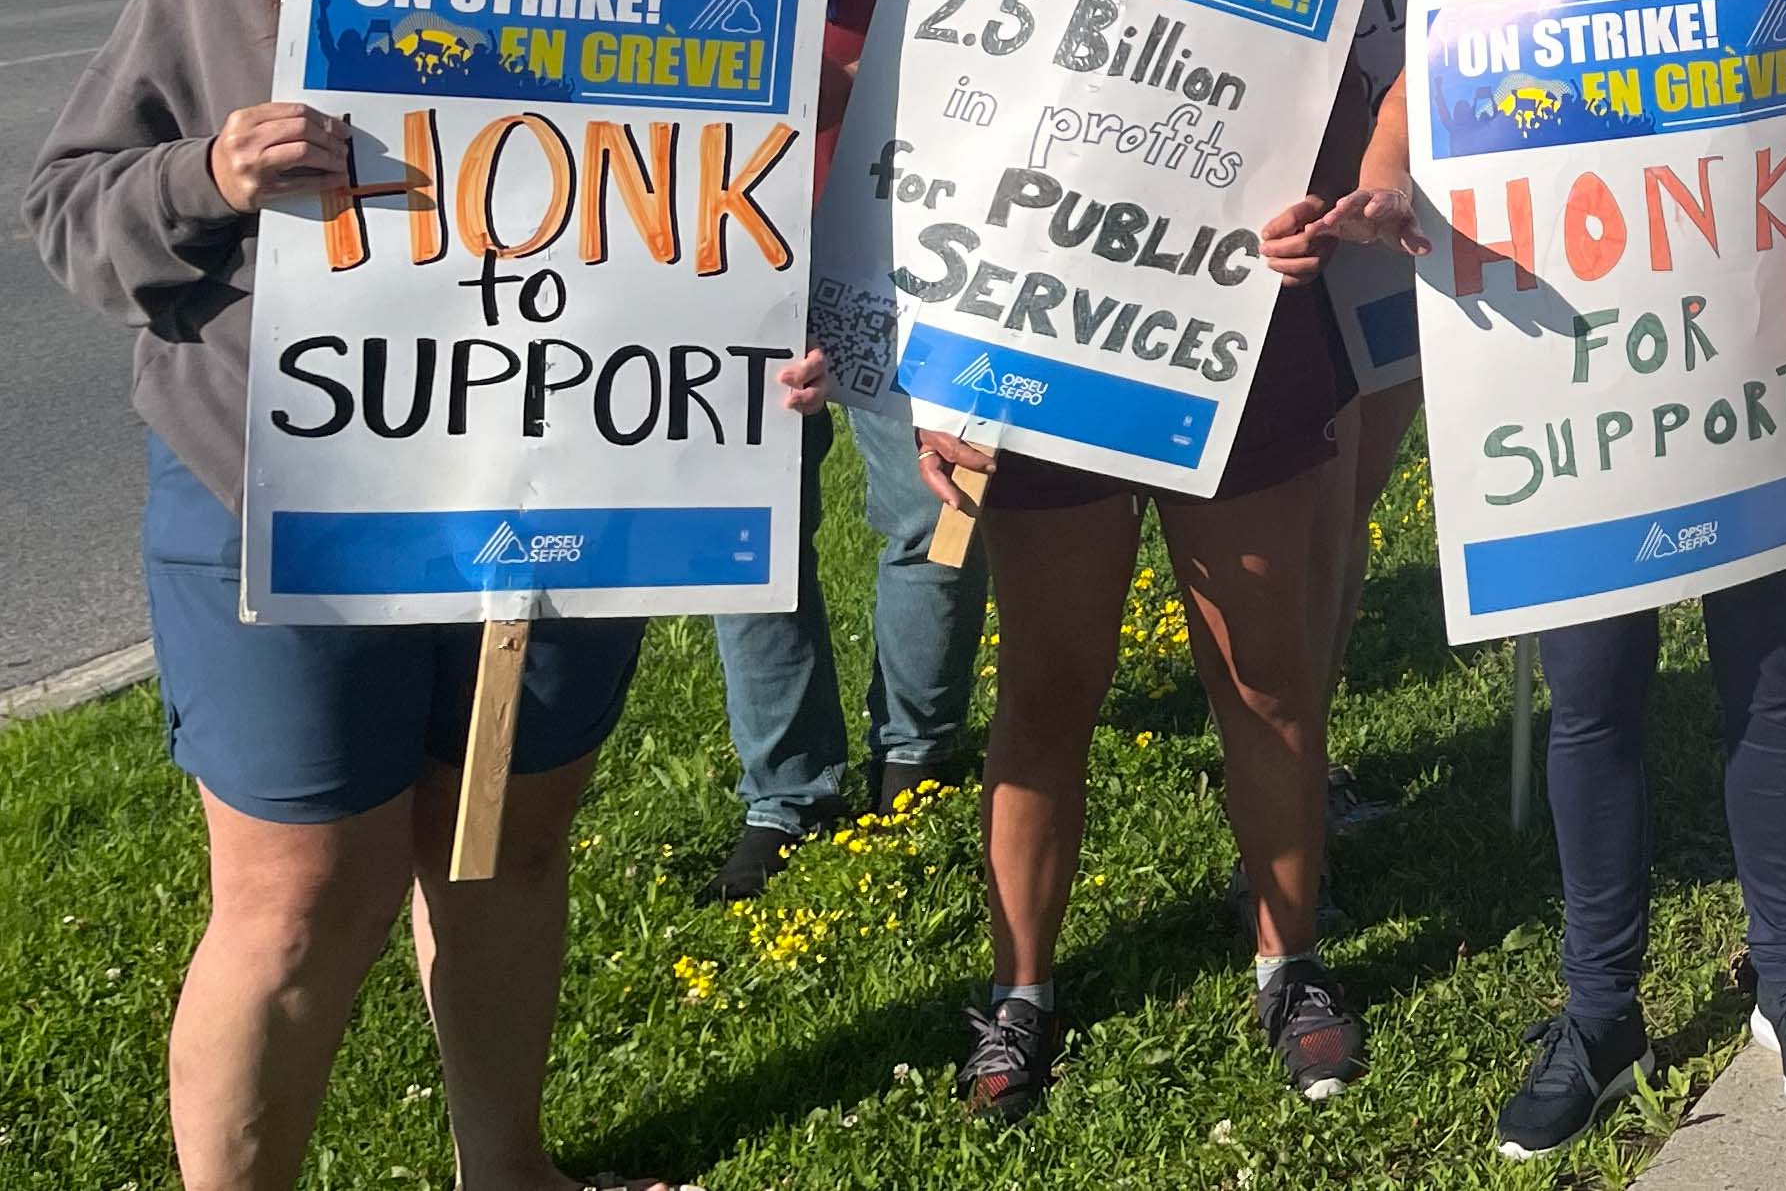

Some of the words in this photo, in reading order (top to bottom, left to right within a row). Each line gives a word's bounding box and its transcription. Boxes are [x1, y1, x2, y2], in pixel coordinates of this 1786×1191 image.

[499, 27, 563, 79] EN
[580, 23, 764, 91] GRÈVE!
[1458, 26, 1520, 78] ON
[1533, 0, 1719, 66] STRIKE!
[1582, 69, 1643, 118] EN
[942, 75, 998, 127] in
[1028, 104, 1243, 189] profits
[320, 109, 799, 276] HONK
[870, 139, 957, 210] for
[985, 166, 1261, 286] PUBLIC
[459, 245, 566, 326] to
[888, 222, 1248, 382] SERVICES
[1572, 295, 1718, 383] FOR
[270, 335, 793, 446] SUPPORT
[997, 385, 1043, 406] SEFPO
[1001, 373, 1049, 395] OPSEU
[529, 548, 581, 562] SEFPO
[531, 535, 584, 549] OPSEU
[1678, 520, 1719, 540] OPSEU
[1678, 533, 1717, 553] SEFPO
